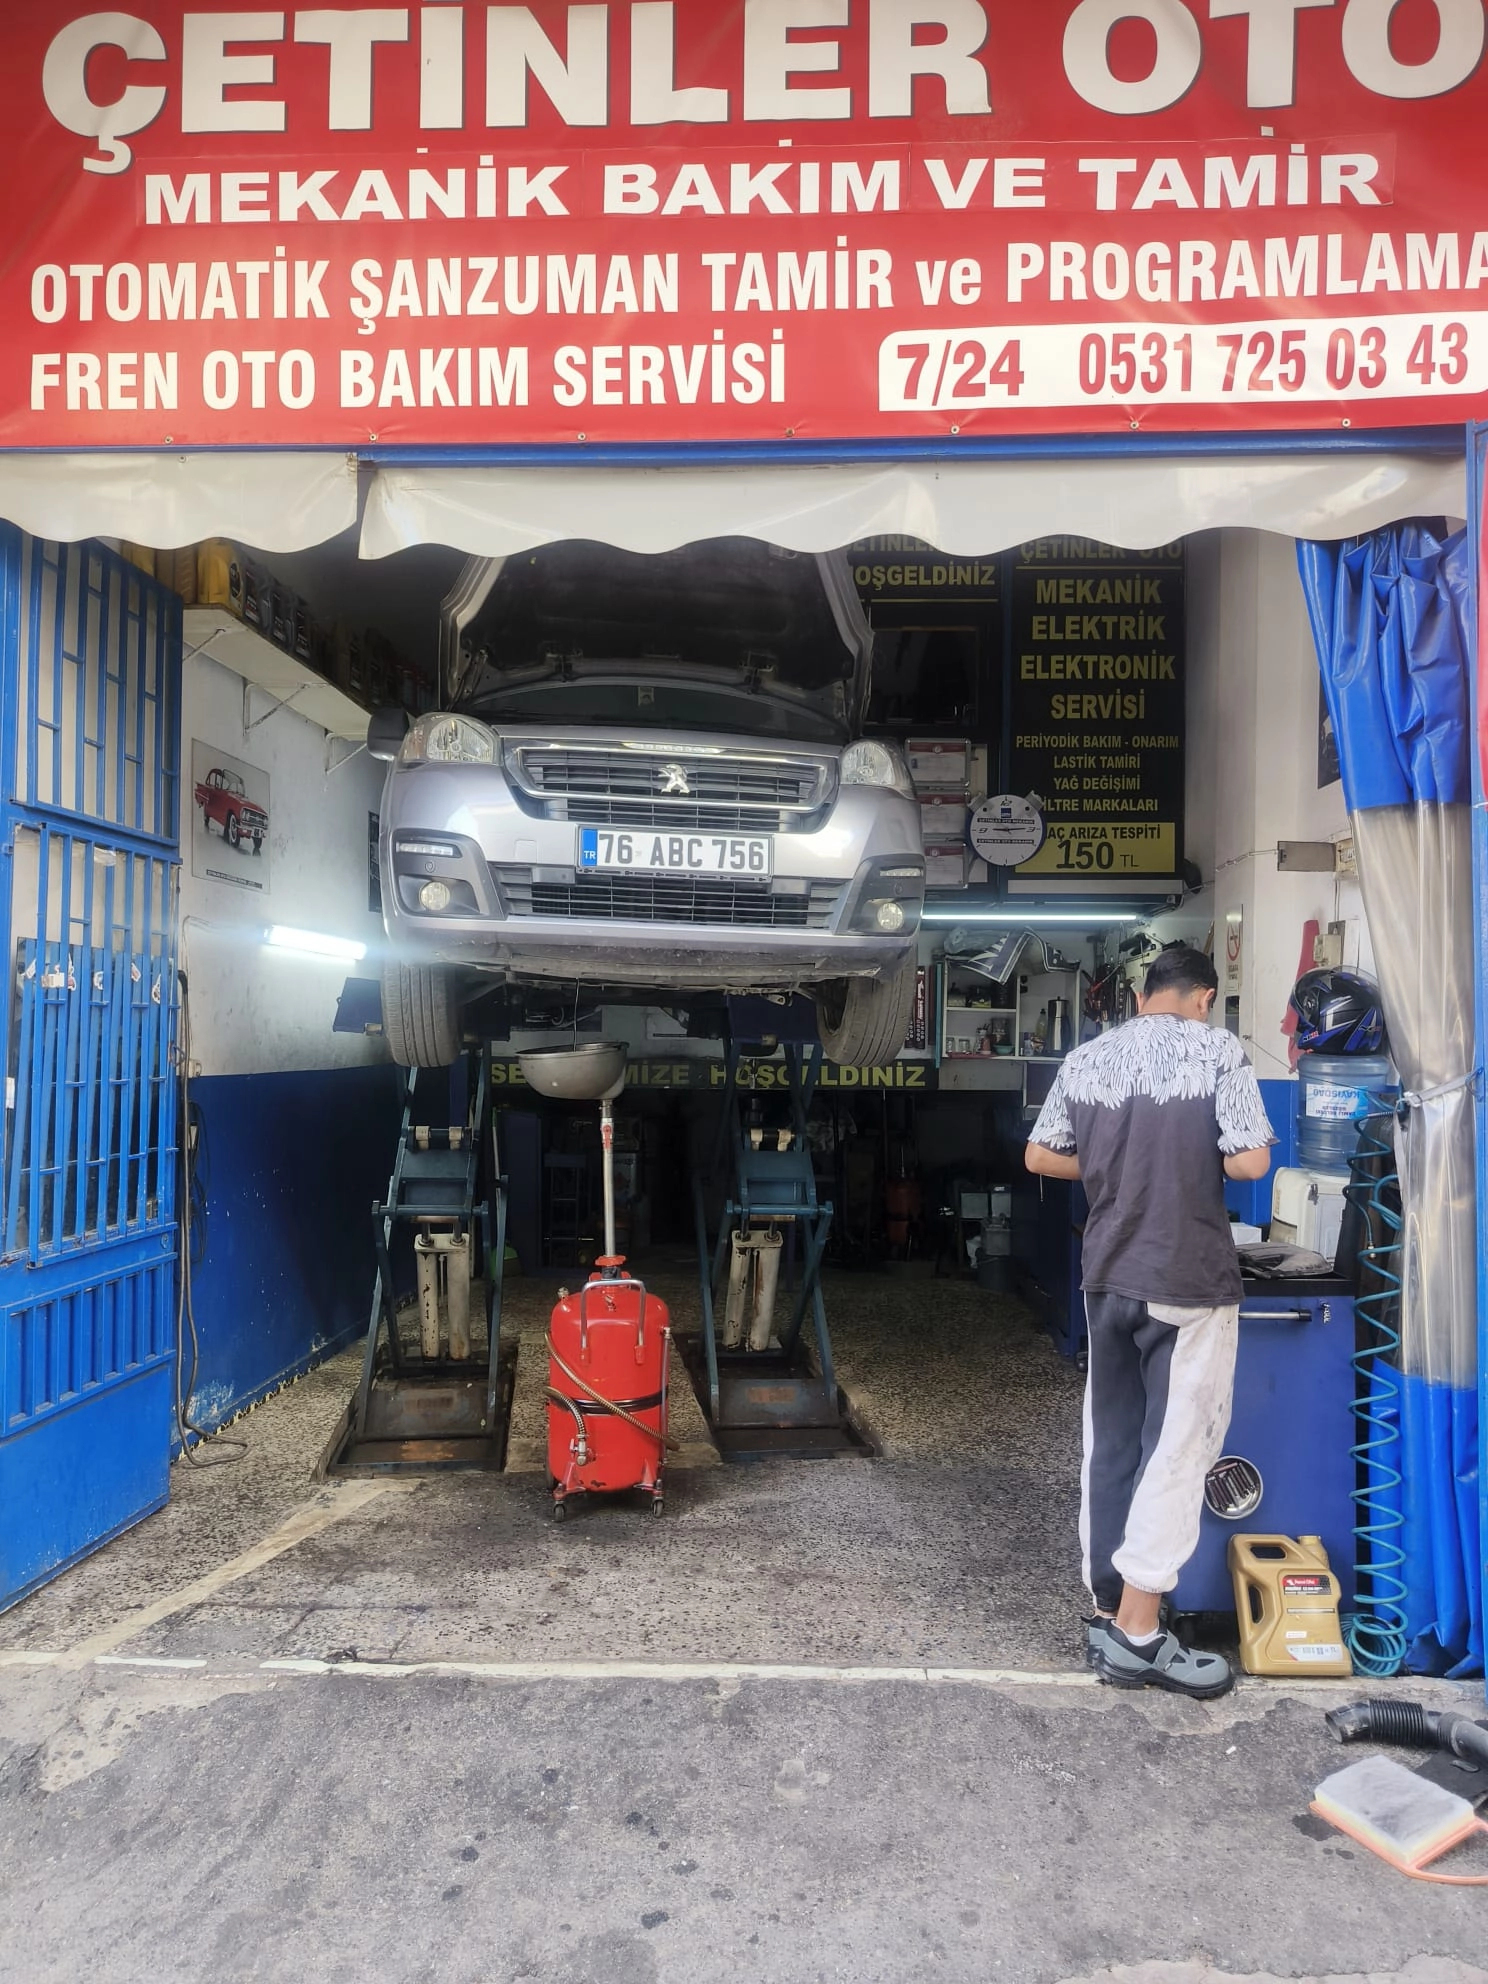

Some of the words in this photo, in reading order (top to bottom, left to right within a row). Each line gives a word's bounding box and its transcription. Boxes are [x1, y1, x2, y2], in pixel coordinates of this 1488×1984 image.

[1063, 0, 1486, 114] OTO
[146, 154, 569, 224] MEKANİK
[604, 160, 899, 215] BAKIM
[924, 158, 1046, 209] VE
[1079, 144, 1380, 210] TAMİR
[31, 246, 329, 323] OTOMATİK
[350, 254, 678, 334] ŞANZUMAN
[702, 236, 893, 311] TAMİR
[916, 259, 981, 305] ve
[1008, 232, 1488, 302] PROGRAMLAMA
[31, 352, 177, 410] FREN
[202, 349, 315, 409] OTO
[341, 347, 528, 407] BAKIM
[554, 329, 784, 406] SERVİSİ
[898, 340, 1024, 406] 7/24
[1080, 333, 1191, 394] 0531
[1218, 330, 1305, 392] 725
[1327, 327, 1386, 390] 03
[1408, 323, 1467, 385] 43
[855, 561, 995, 590] OŞGELDİNİZ
[1036, 574, 1162, 604] MEKANİK
[1032, 610, 1166, 640] ELEKTRİK
[1021, 649, 1176, 680] ELEKTRONİK
[1051, 688, 1145, 719] SERVİSİ
[1016, 733, 1079, 748] PERİYODİK
[1083, 736, 1121, 748] BAKIM
[1132, 736, 1179, 748] ONARIM
[1054, 753, 1096, 768] LASTİK
[1100, 753, 1140, 768] TAMİRİ
[1054, 775, 1078, 790] YAĞ
[1083, 775, 1140, 792] DEĞİŞİMİ
[1042, 796, 1079, 811] İLTRE
[1083, 799, 1158, 811] MARKALARI
[1069, 828, 1107, 839] ARIZA
[1112, 824, 1160, 839] TESPİTİ
[584, 850, 596, 861] TR
[599, 834, 633, 864] 76
[650, 837, 703, 868] ABC
[711, 840, 764, 870] 756
[1056, 839, 1114, 870] 150
[1120, 854, 1139, 867] TL
